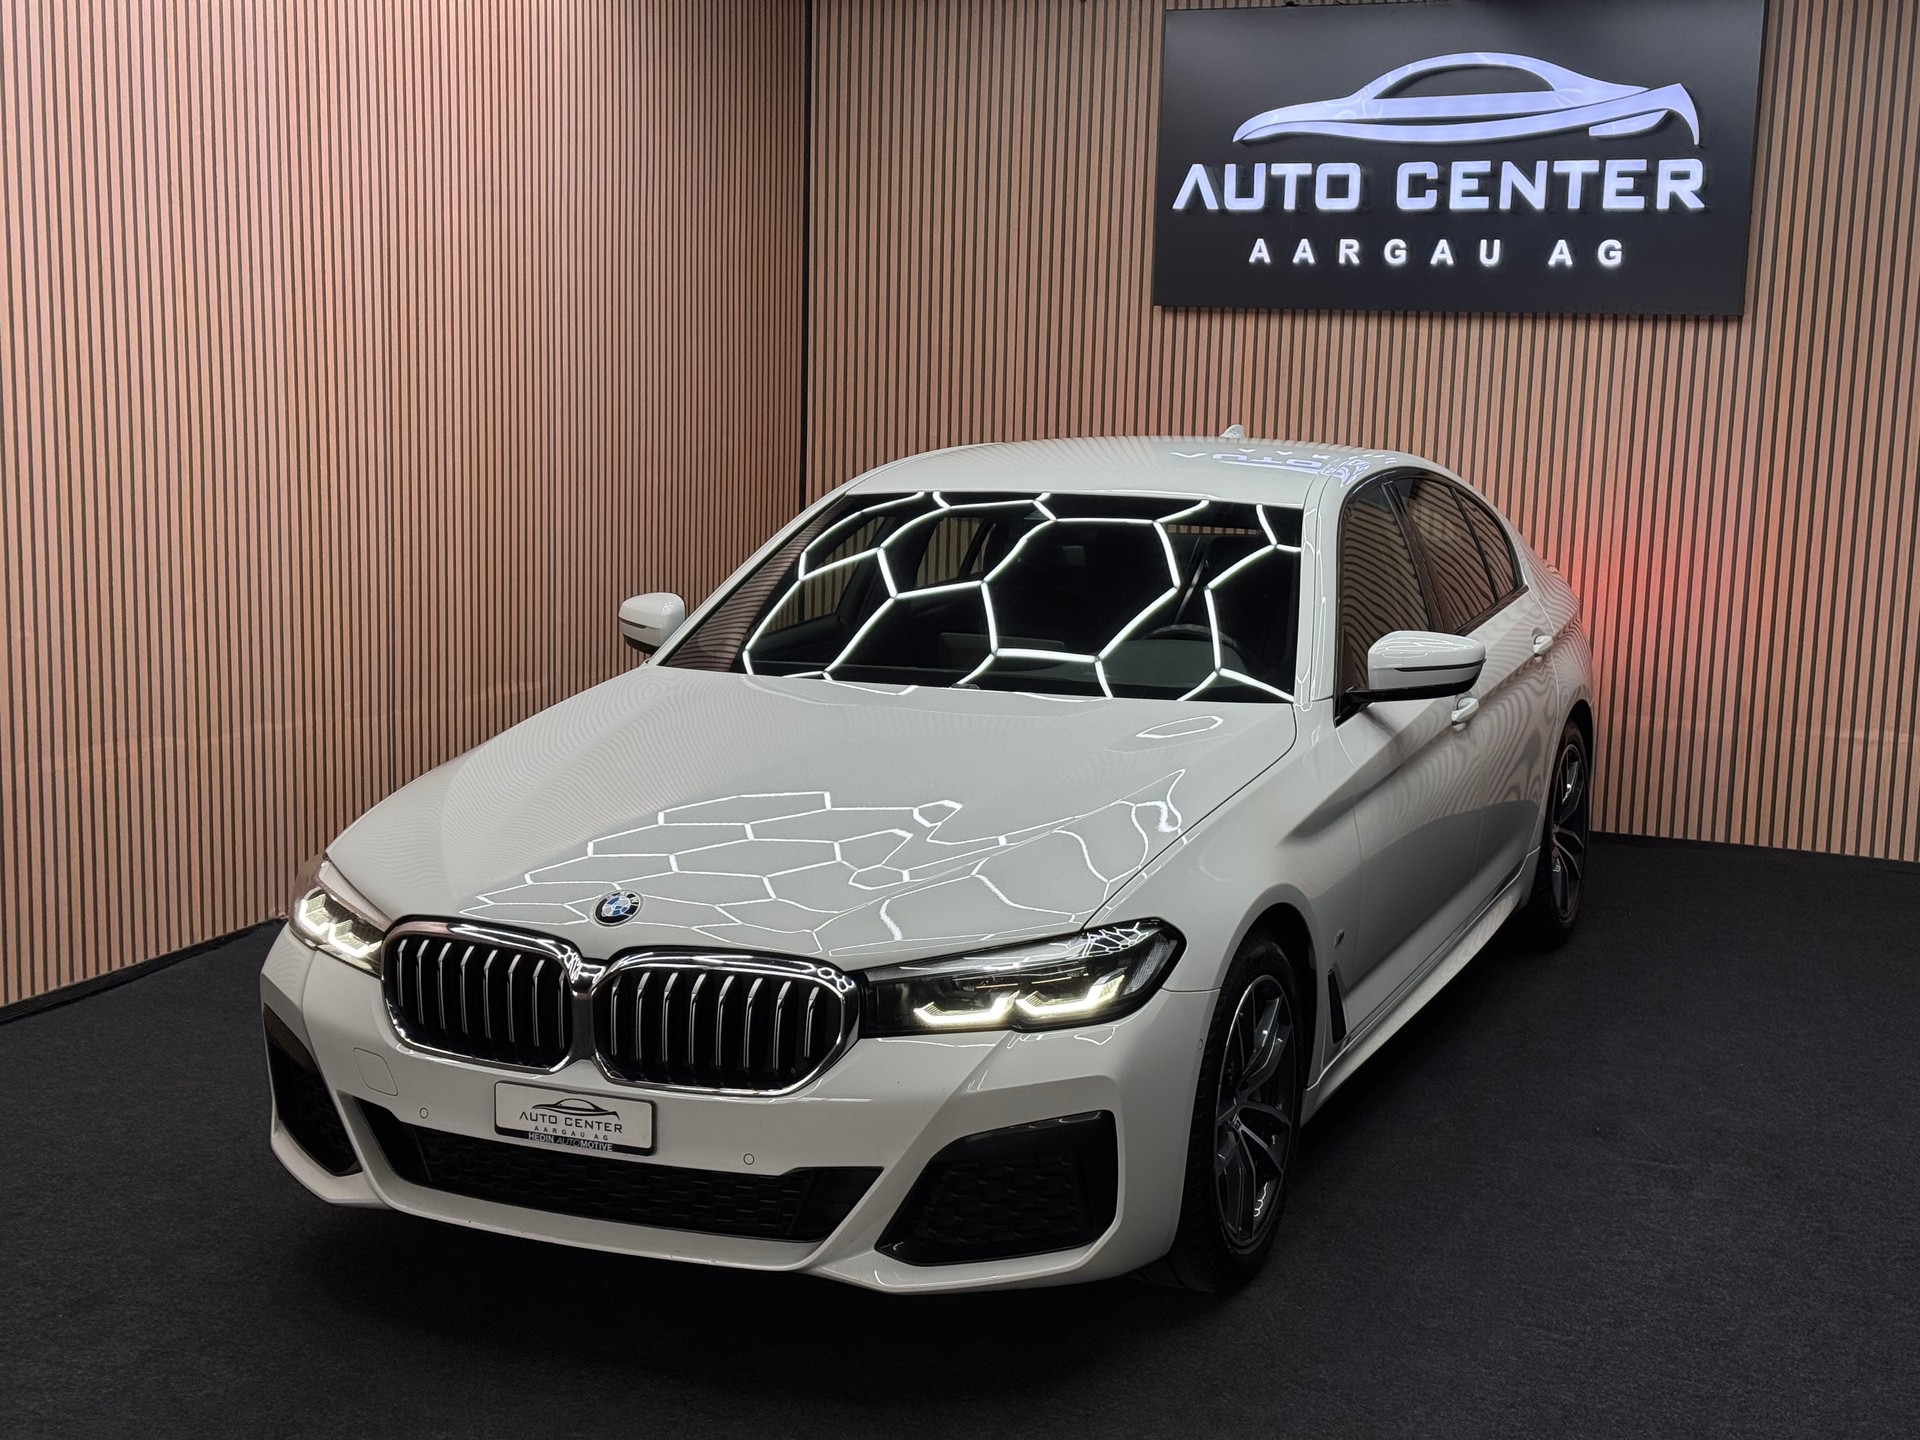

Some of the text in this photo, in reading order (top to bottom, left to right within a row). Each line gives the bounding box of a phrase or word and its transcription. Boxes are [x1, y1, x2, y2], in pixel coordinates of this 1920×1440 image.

[1172, 158, 1705, 211] AUTO CENTER
[1248, 238, 1623, 266] AARGAU AG
[519, 1111, 623, 1134] AUTO CENTER
[534, 1125, 609, 1141] AARGAU AG
[528, 1131, 613, 1152] HEDIN AUTOMOTIVE
